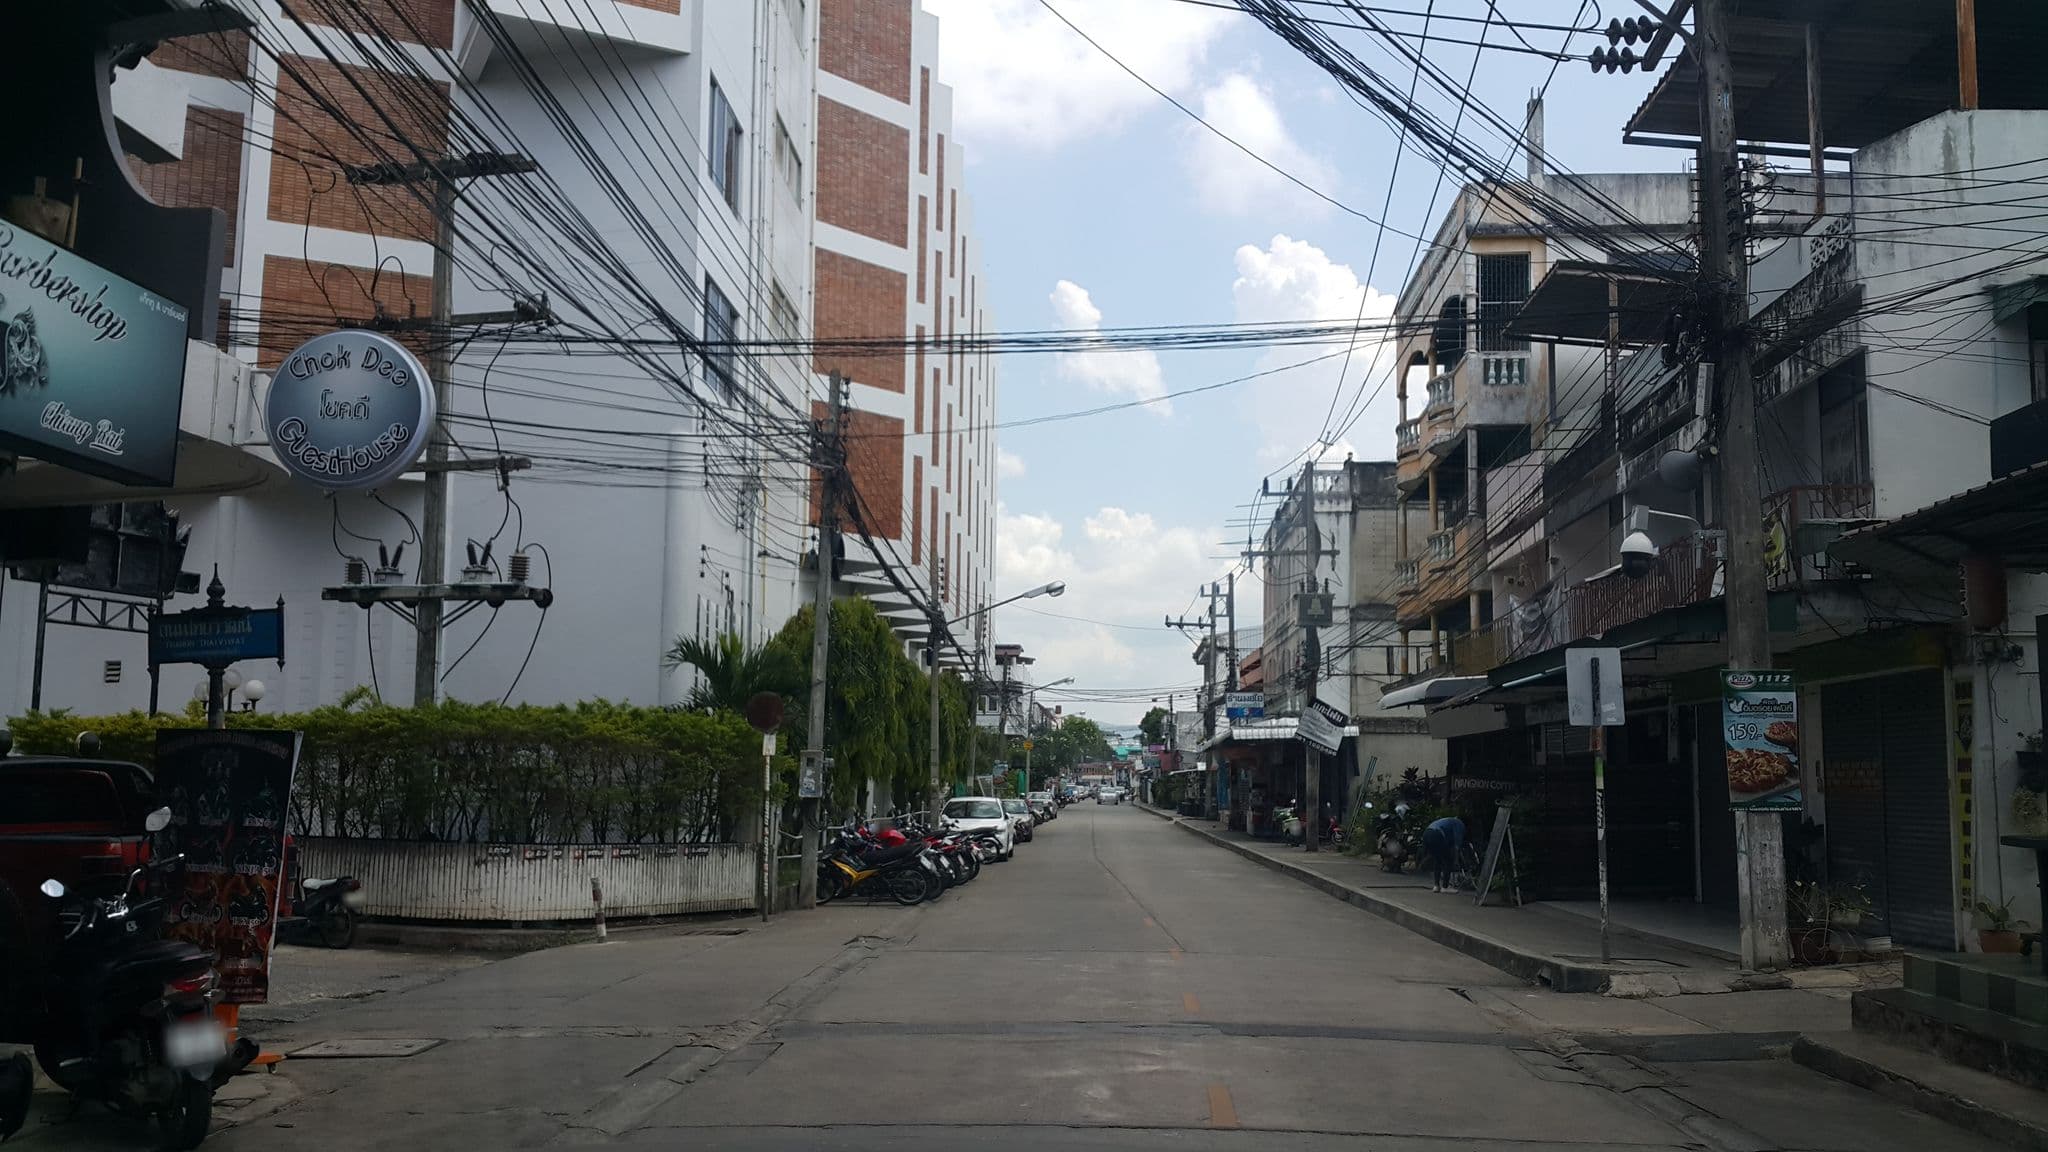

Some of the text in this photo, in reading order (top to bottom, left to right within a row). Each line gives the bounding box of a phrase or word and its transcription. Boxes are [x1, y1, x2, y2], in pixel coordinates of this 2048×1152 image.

[289, 344, 410, 387] Chok Dee
[319, 388, 370, 420] โชคดี
[40, 400, 125, 455] Chiang Rai
[1757, 674, 1791, 683] 1112
